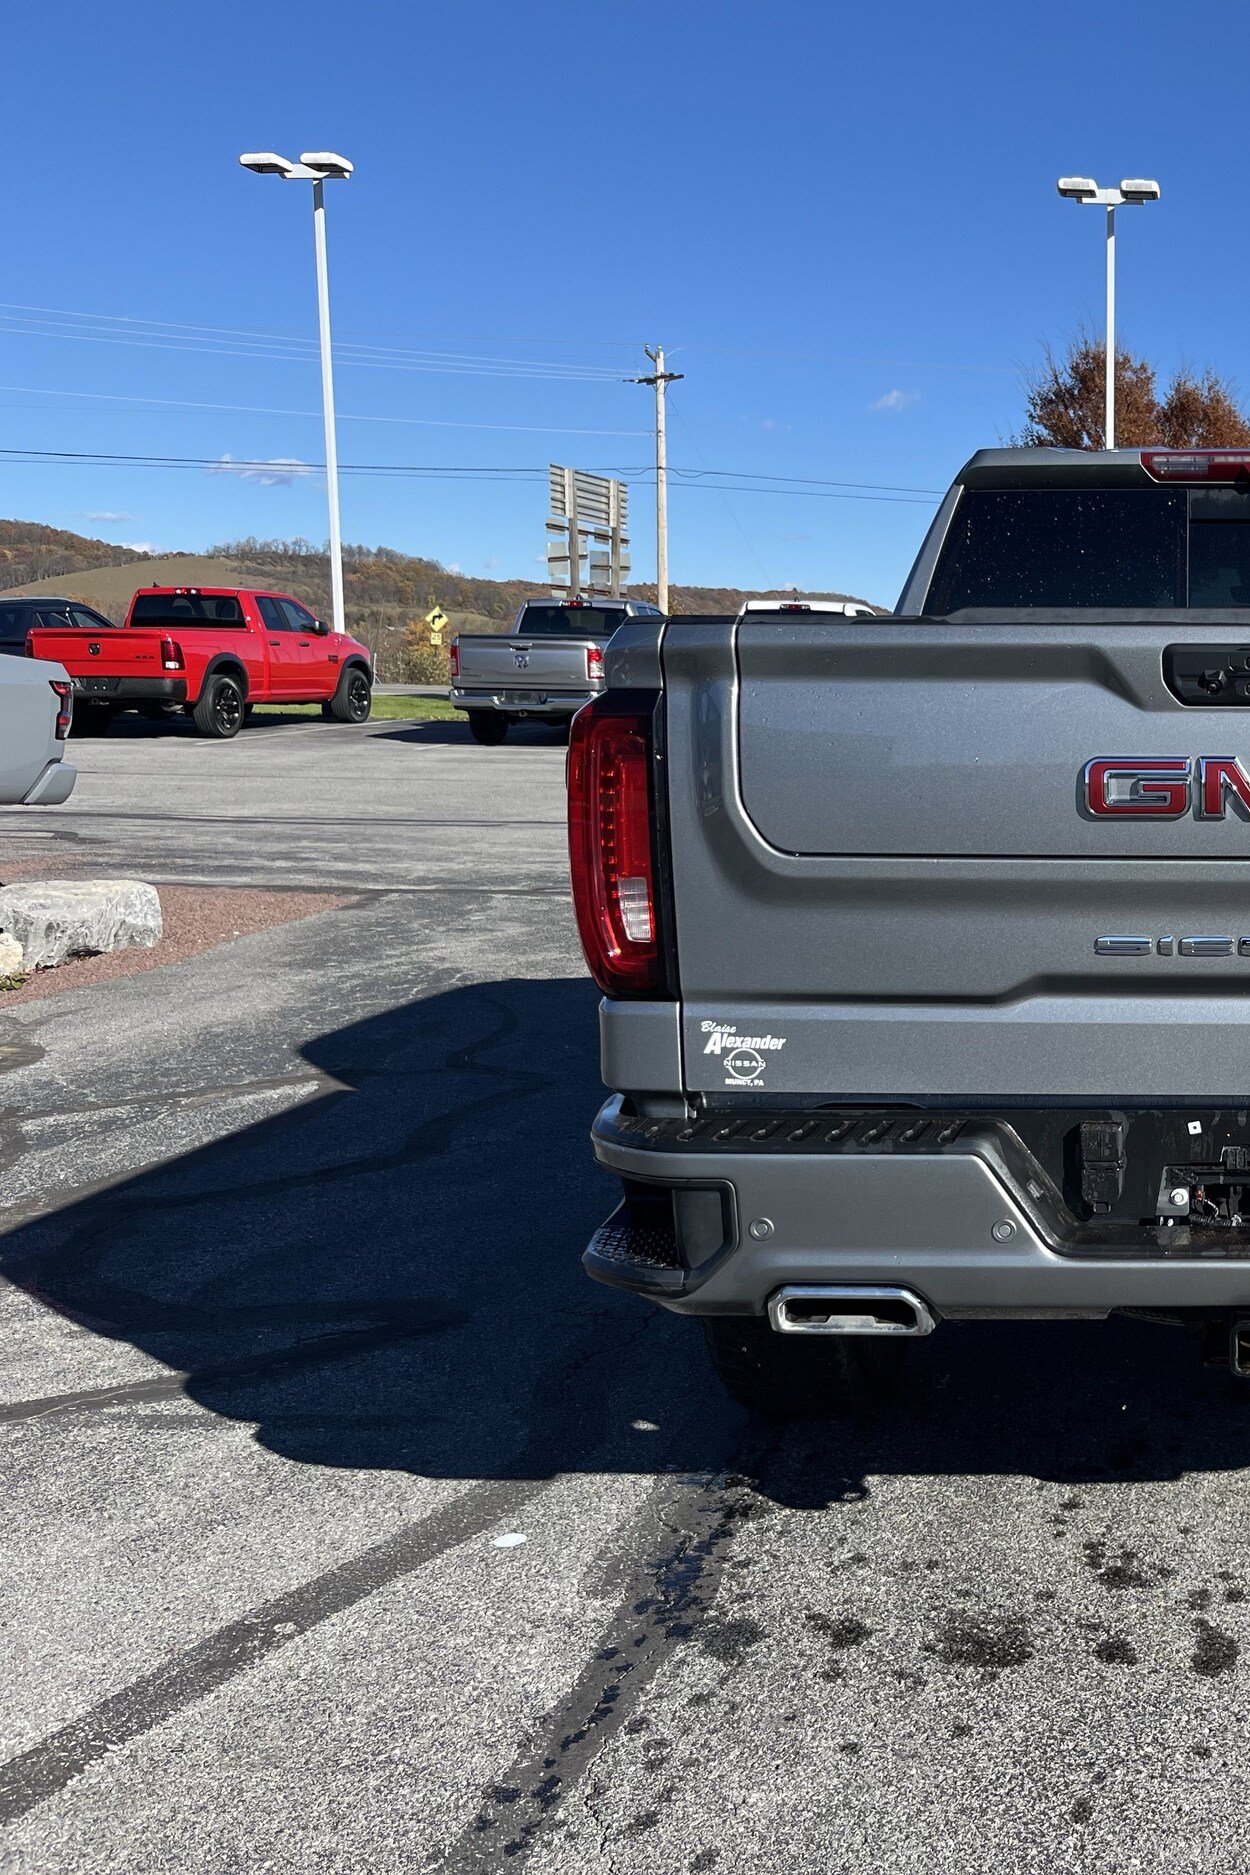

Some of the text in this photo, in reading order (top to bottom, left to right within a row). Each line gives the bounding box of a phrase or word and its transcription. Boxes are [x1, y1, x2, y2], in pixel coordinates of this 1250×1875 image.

[701, 1021, 737, 1033] Blaise
[703, 1033, 786, 1055] Alexander
[723, 1060, 767, 1068] NISSAN
[725, 1078, 753, 1087] MUNCY,
